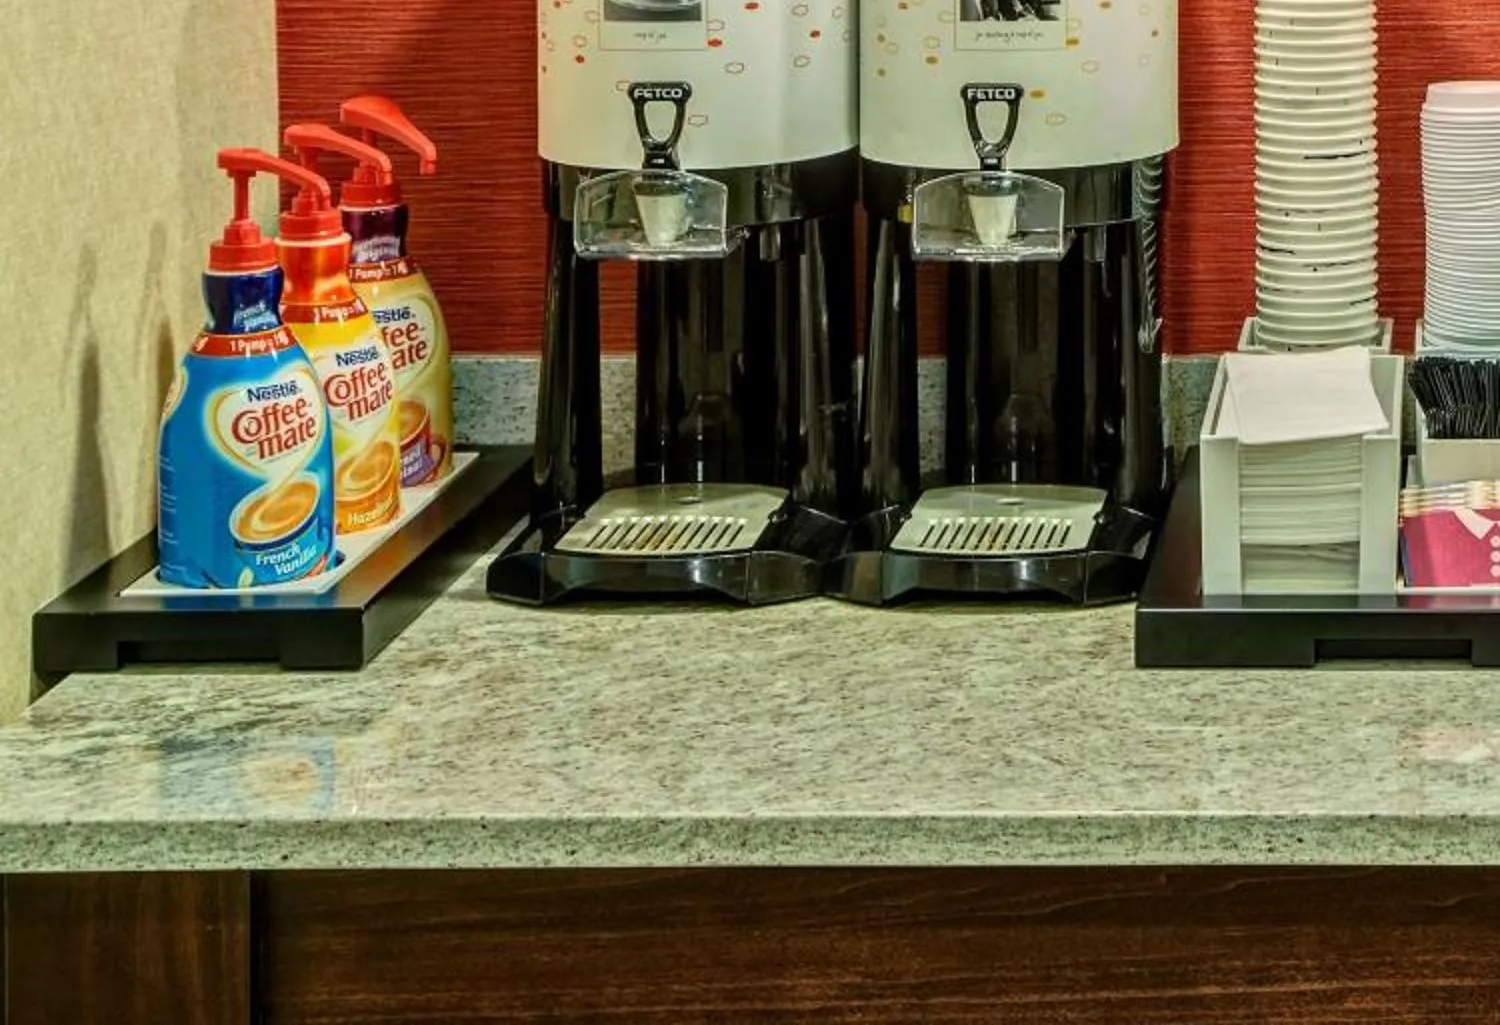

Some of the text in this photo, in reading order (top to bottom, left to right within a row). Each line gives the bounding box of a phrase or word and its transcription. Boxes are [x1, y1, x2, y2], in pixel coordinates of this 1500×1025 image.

[633, 88, 683, 99] FETCO
[967, 88, 1015, 100] FETCO
[391, 340, 428, 370] ate
[323, 363, 388, 407] Coffee
[347, 379, 393, 421] mate
[231, 398, 308, 444] Coffee
[257, 416, 317, 460] mate
[255, 541, 301, 566] French
